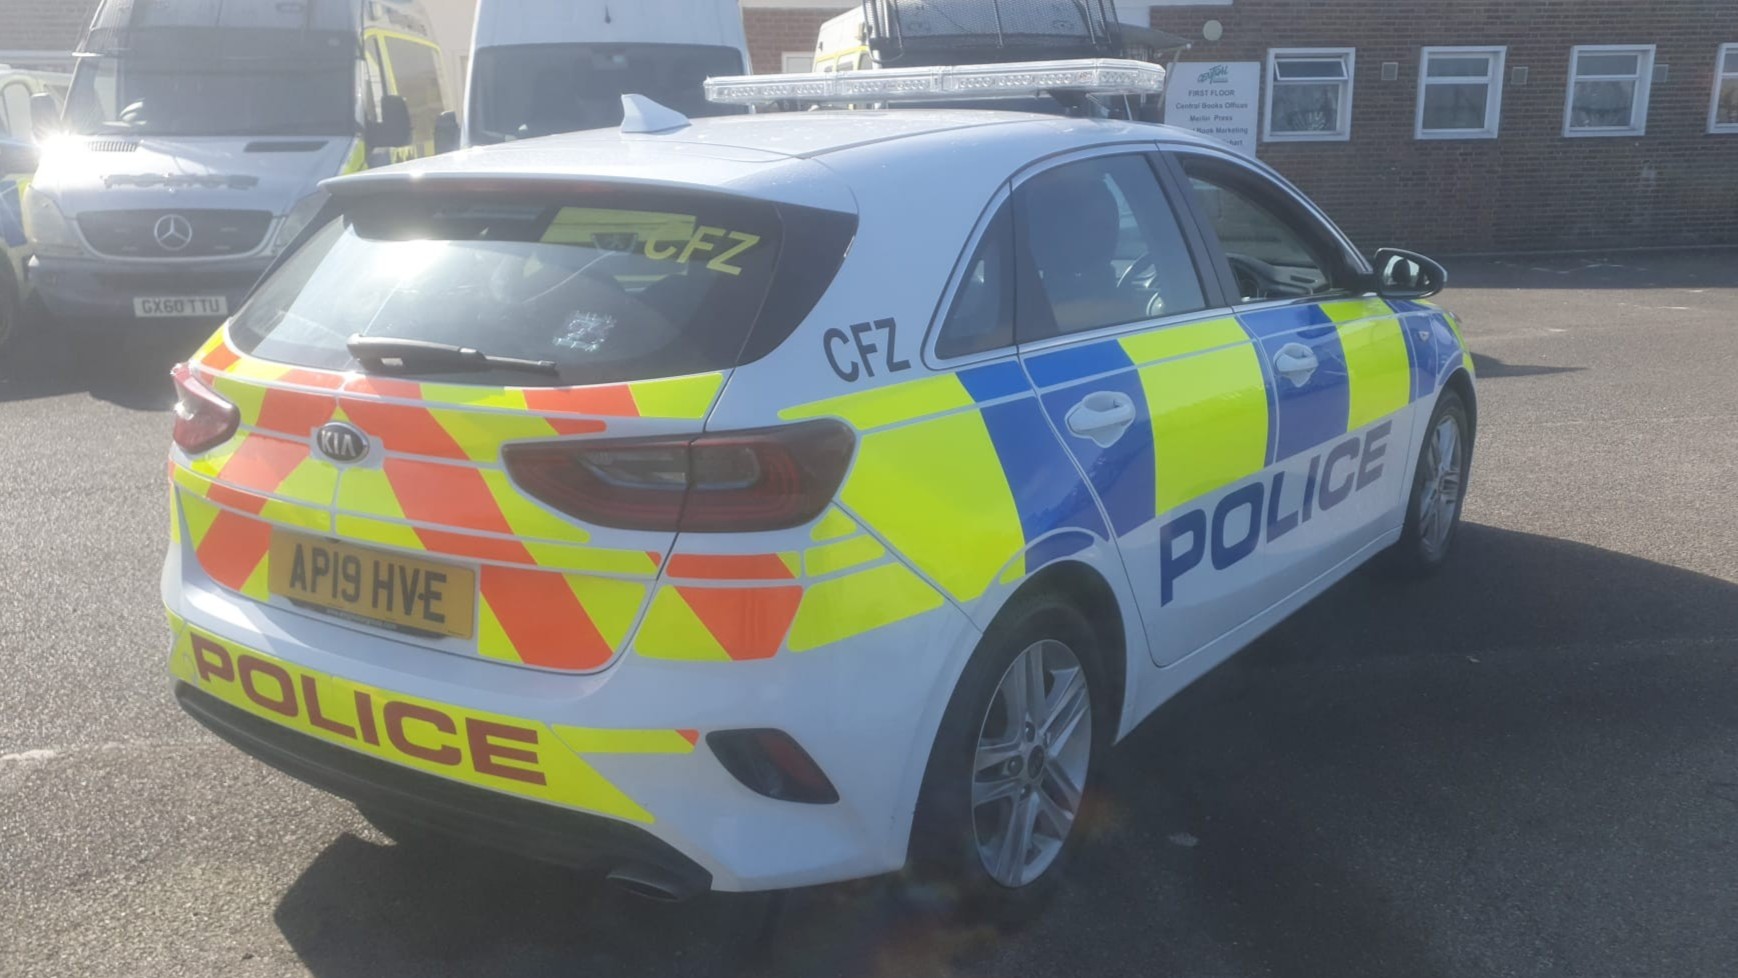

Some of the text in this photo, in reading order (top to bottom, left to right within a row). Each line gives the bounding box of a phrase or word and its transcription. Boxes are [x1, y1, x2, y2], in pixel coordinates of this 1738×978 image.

[1188, 89, 1235, 97] FIRST FLOOR
[644, 225, 760, 276] CFZ
[142, 299, 220, 314] GX60 TTU
[823, 317, 911, 382] CFZ
[321, 430, 356, 457] KIA
[1159, 420, 1392, 608] POLICE
[289, 543, 447, 624] AP19 HVE
[189, 631, 547, 786] POLICE
